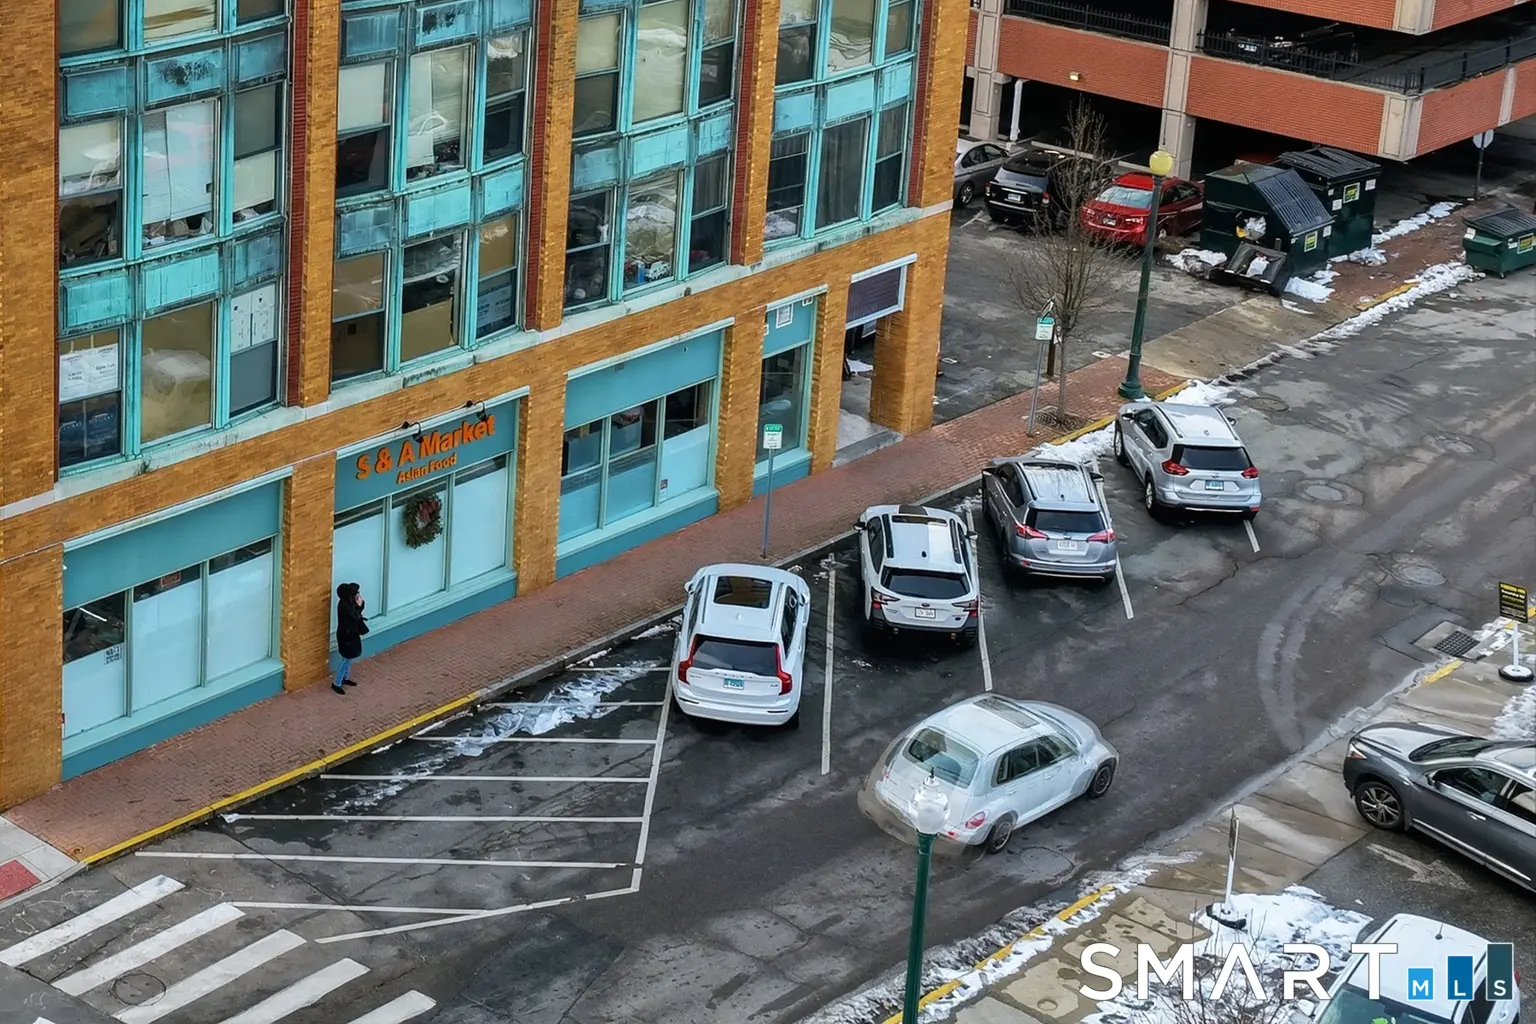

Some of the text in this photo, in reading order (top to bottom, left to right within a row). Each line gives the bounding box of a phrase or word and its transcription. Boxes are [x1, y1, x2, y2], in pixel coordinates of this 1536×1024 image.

[356, 414, 497, 480] S & A Market
[396, 452, 458, 485] Asian Food
